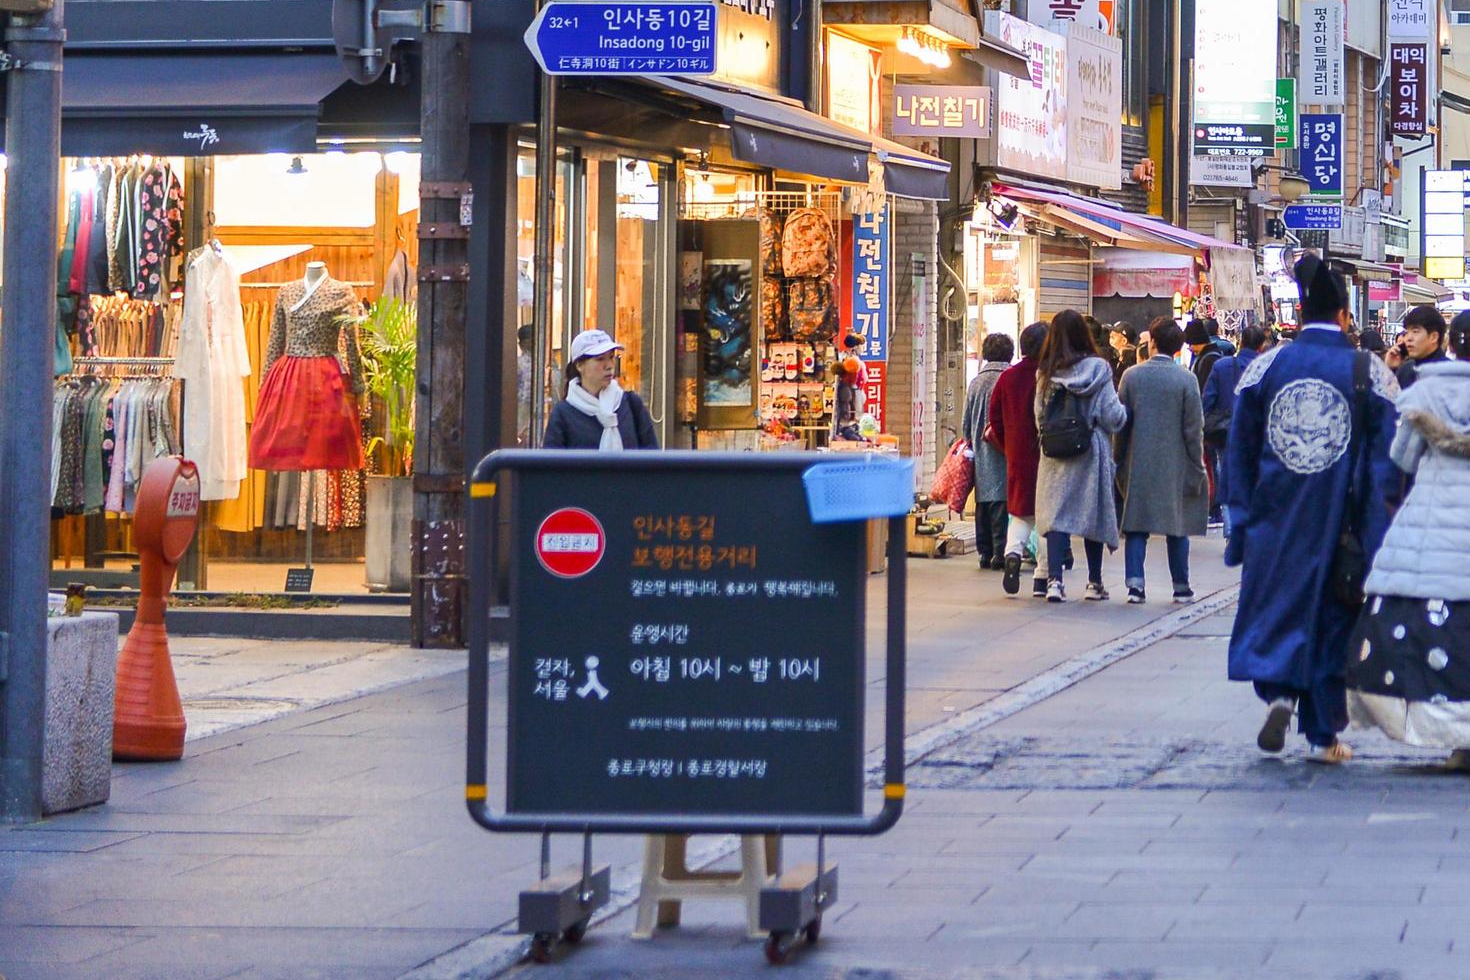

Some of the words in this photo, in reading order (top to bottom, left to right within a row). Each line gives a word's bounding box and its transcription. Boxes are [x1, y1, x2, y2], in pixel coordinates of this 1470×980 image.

[549, 17, 564, 29] 32
[602, 7, 711, 32] 인사동10길
[1391, 13, 1428, 25] 아카데미
[599, 35, 665, 52] Insadong
[670, 35, 711, 52] 10-gil
[1313, 7, 1328, 97] 평화아트갤러리
[558, 57, 620, 71] 仁寺洞10街
[627, 58, 710, 71] インサドン10ギル
[1393, 47, 1425, 65] 대익
[1398, 68, 1419, 119] 보이차
[896, 95, 985, 129] 나전칠기
[1314, 121, 1338, 185] 명신당
[856, 205, 885, 338] 나전칠기
[631, 514, 717, 542] 인사동길
[630, 544, 757, 571] 보행전용거리
[629, 623, 690, 645] 운영시간
[629, 655, 672, 683] 아침
[680, 655, 722, 682] 10시
[778, 655, 822, 682] 10시
[532, 678, 571, 702] 서울
[606, 758, 675, 779] 종로구청장
